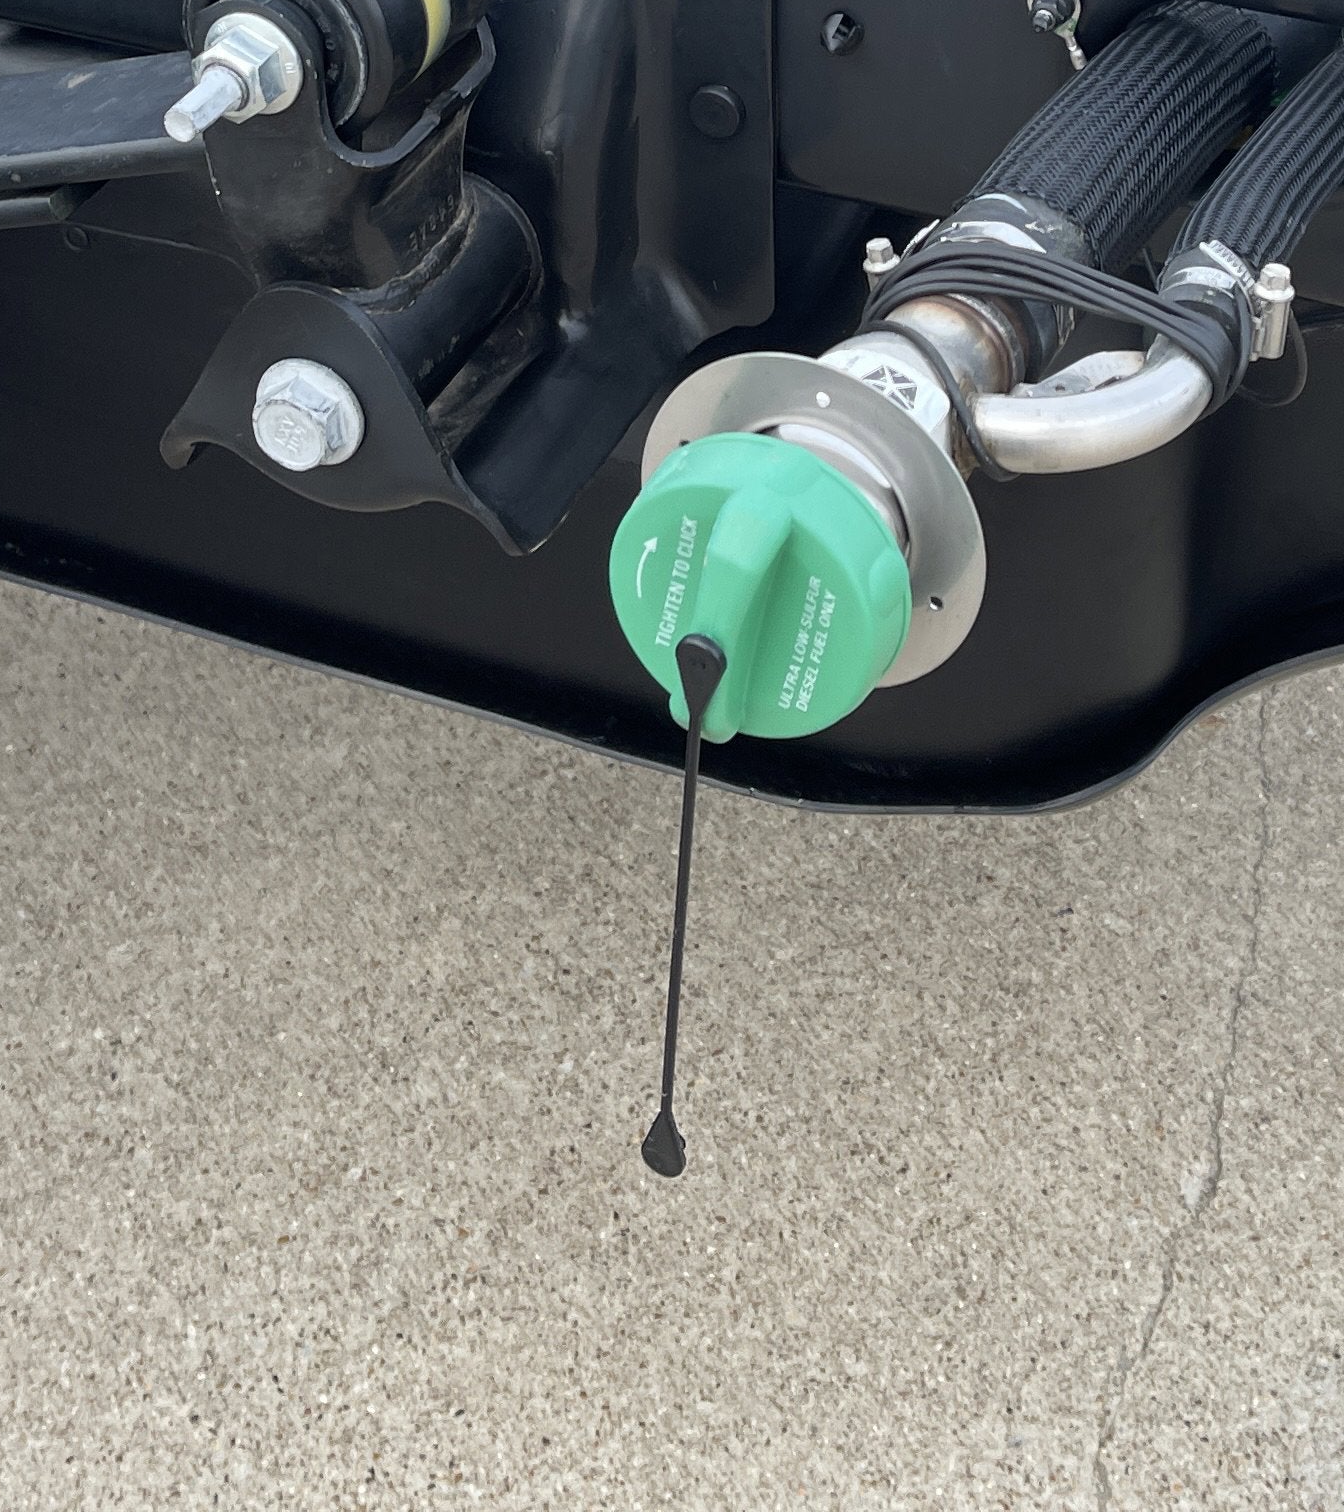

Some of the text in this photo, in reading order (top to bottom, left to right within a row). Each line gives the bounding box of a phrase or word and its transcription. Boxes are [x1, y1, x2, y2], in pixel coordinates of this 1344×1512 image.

[655, 516, 697, 647] TIGHTEN TO CLICK
[778, 576, 821, 709] ULTRA LOW-SULFUR
[796, 589, 836, 712] DIESEL FUEL ONLY
